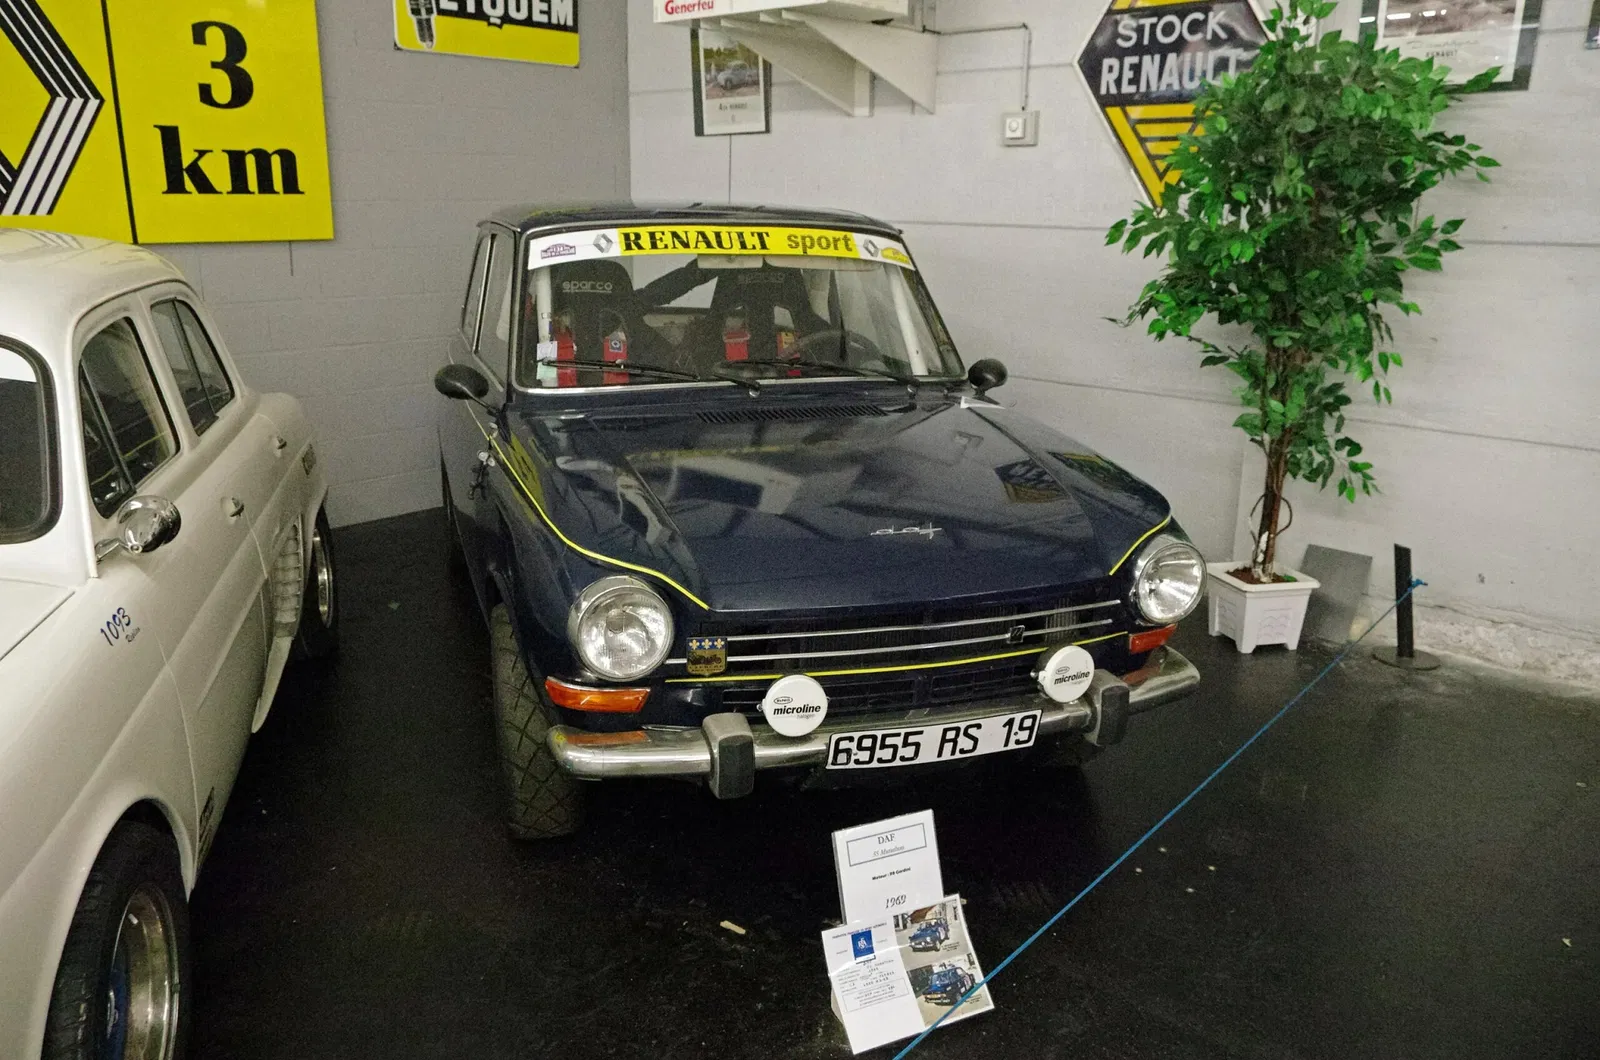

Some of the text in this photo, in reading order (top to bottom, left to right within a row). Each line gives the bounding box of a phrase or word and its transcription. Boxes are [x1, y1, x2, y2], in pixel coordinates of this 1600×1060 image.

[1116, 10, 1228, 48] STOCK
[190, 20, 254, 110] 3
[1099, 47, 1244, 95] RENAULT
[153, 124, 305, 195] km
[621, 230, 853, 254] RENAULT sport
[562, 280, 613, 294] sparco
[100, 606, 131, 647] 1093
[1053, 671, 1091, 685] microline
[773, 704, 821, 716] microline
[831, 713, 1039, 766] 6955 RS 19
[877, 833, 896, 845] DAF
[885, 894, 907, 909] 1969
